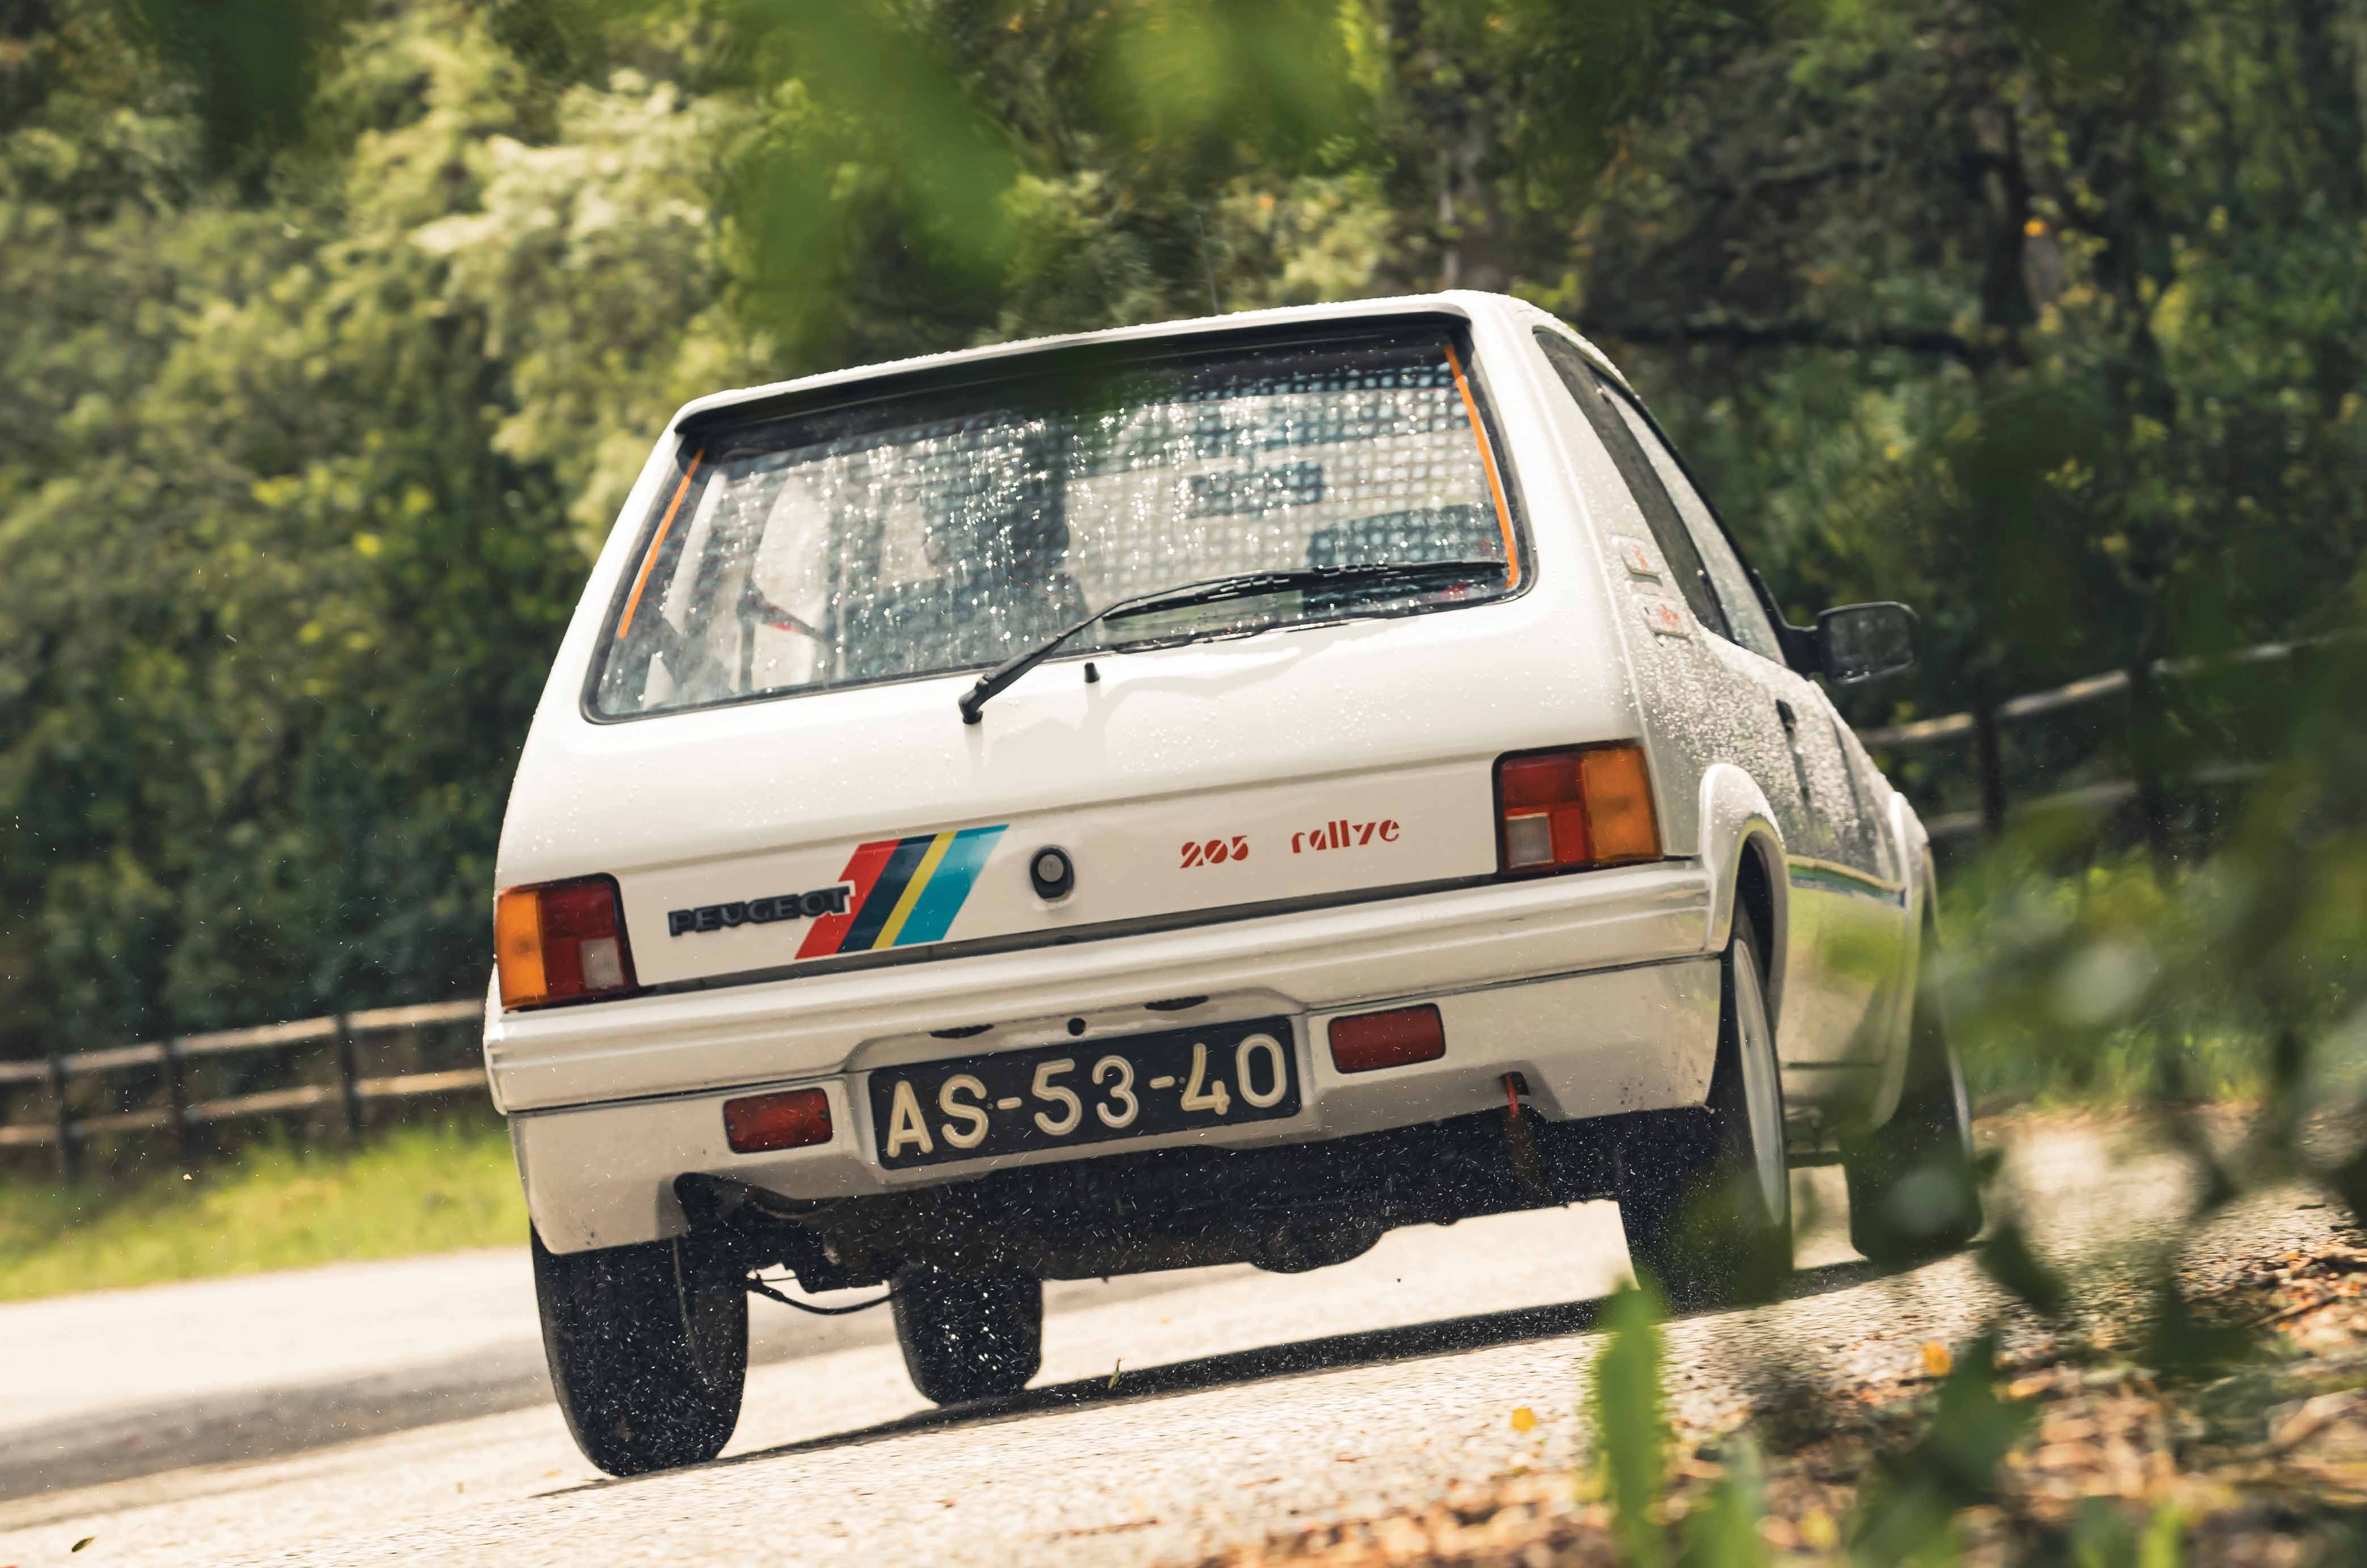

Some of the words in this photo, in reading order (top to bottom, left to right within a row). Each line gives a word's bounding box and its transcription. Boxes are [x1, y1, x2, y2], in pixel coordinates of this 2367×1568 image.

[1180, 835, 1249, 869] 205
[1291, 819, 1400, 853] rallye
[668, 885, 850, 937] PEUGEOT
[887, 1033, 1288, 1158] AS-53-40
